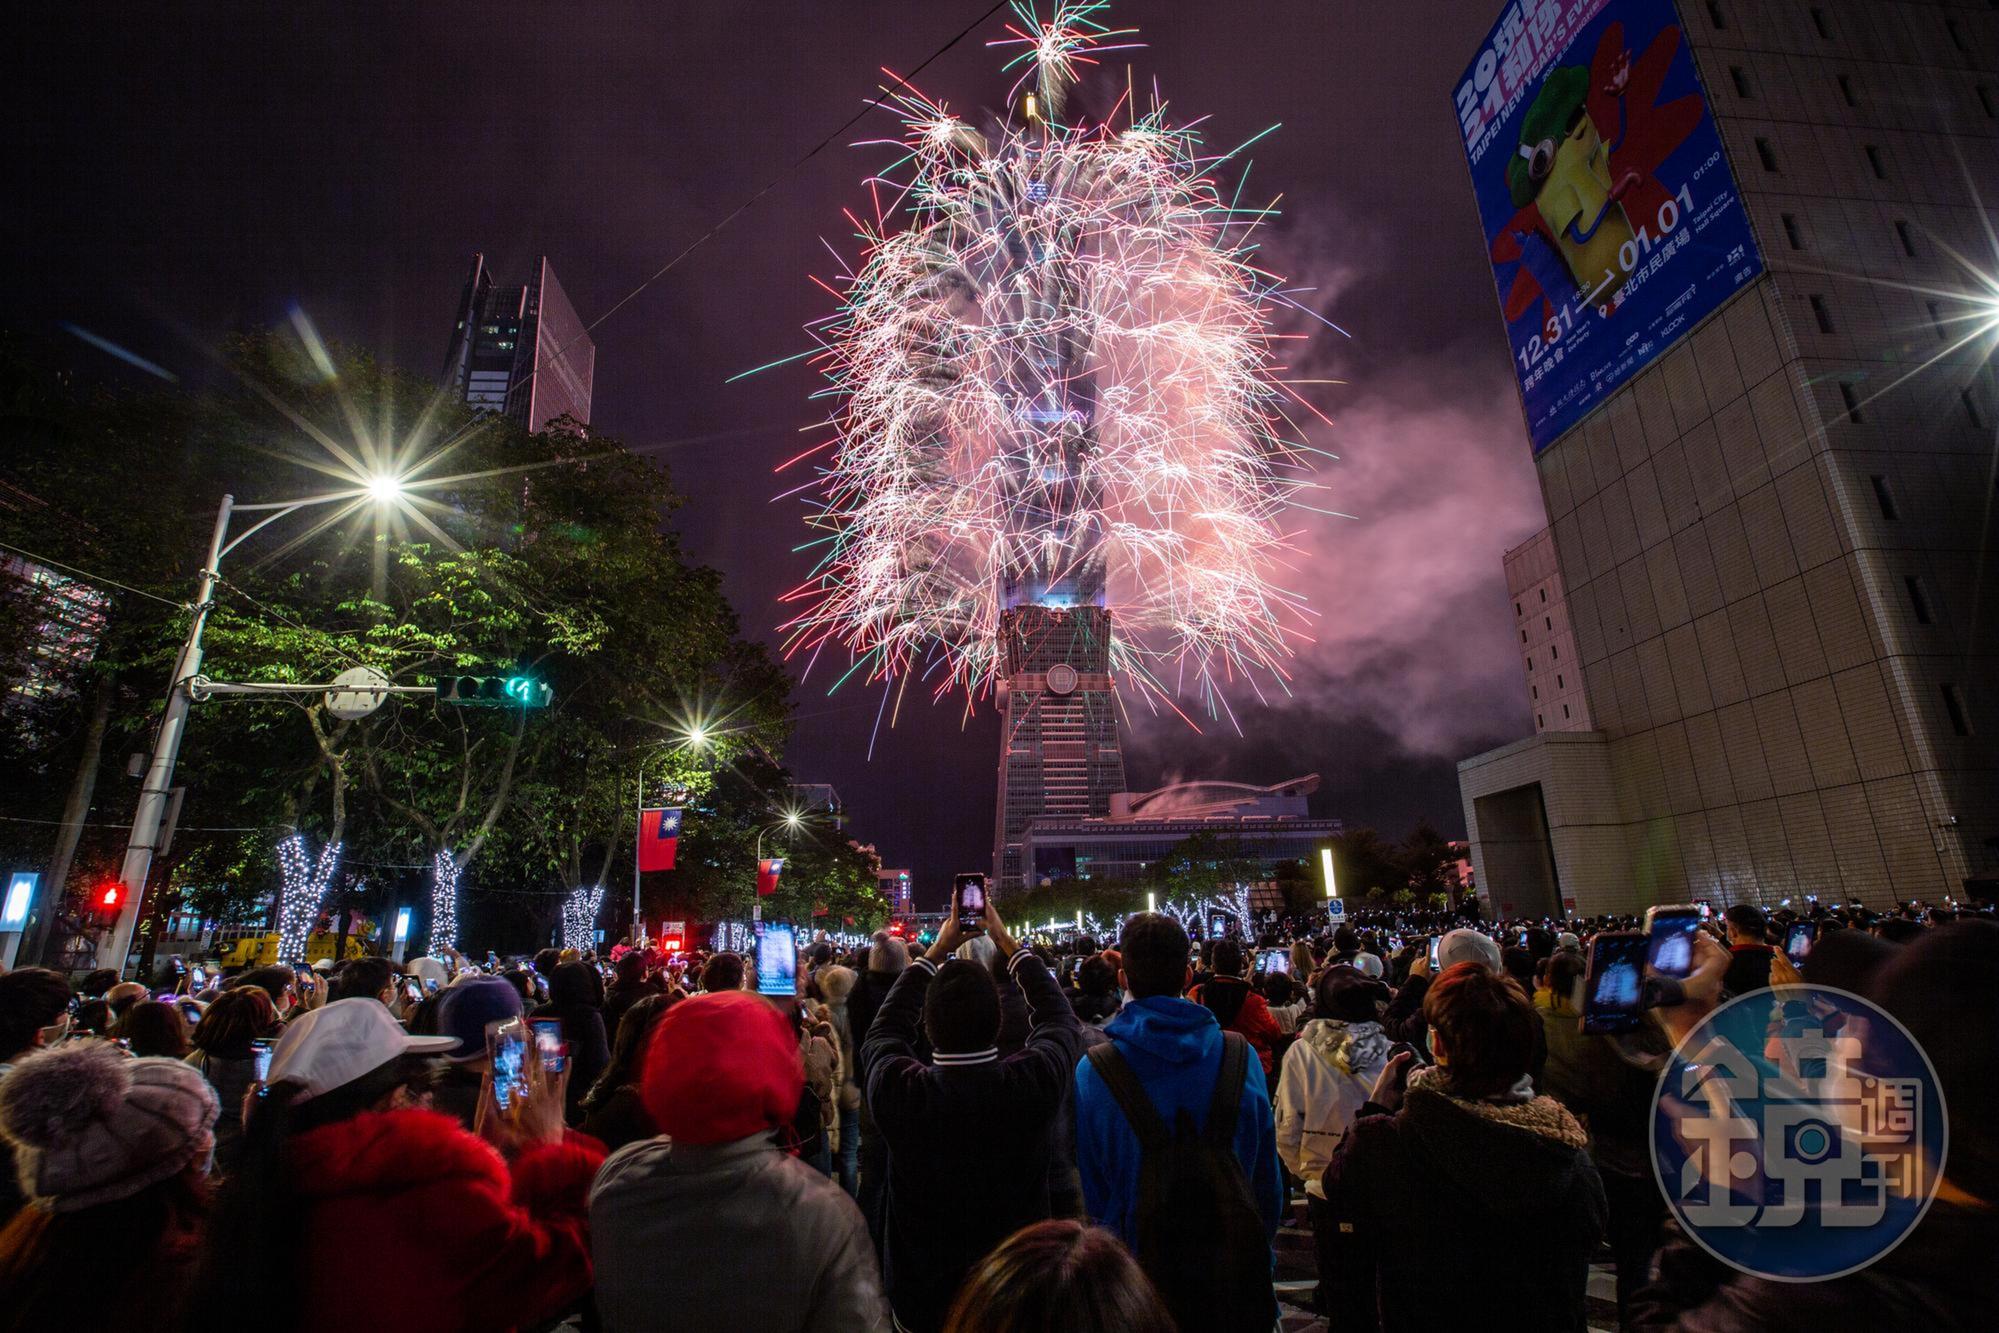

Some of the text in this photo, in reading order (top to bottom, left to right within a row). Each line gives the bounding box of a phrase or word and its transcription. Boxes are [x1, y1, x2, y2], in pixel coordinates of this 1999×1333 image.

[1470, 0, 1590, 166] TAIPEI NEW YEAR'S EV
[1618, 151, 1720, 273] 01.01 01:00
[1692, 190, 1729, 225] Taipei City
[1695, 196, 1735, 235] Hall Square
[1612, 226, 1691, 310] 臺北市民廣場
[1518, 303, 1573, 371] 12.31
[1660, 313, 1686, 338] KLOOK
[1523, 346, 1565, 392] 跨年晚會
